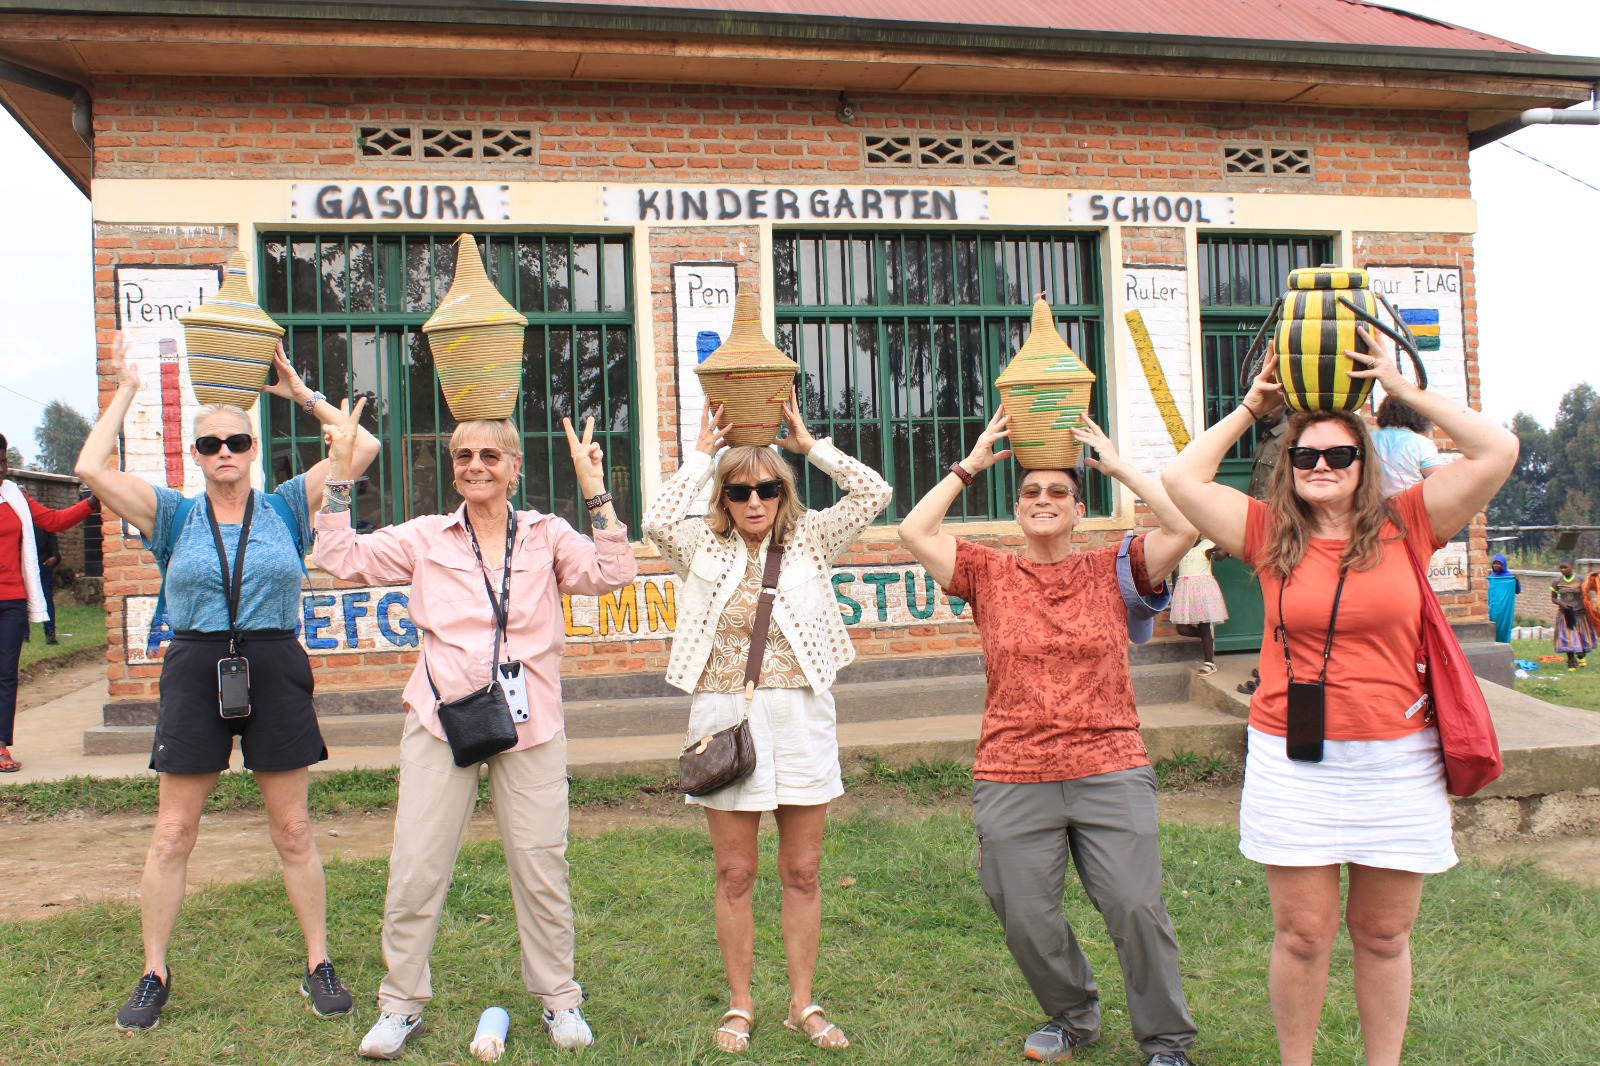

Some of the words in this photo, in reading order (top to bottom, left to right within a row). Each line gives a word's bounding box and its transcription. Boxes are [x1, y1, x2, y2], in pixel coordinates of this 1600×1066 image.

[316, 184, 484, 220] GASURA
[638, 187, 959, 221] KINDERGARTEN
[1089, 194, 1212, 223] SCHOOL
[687, 273, 730, 307] Pen
[1413, 270, 1458, 294] FLAG
